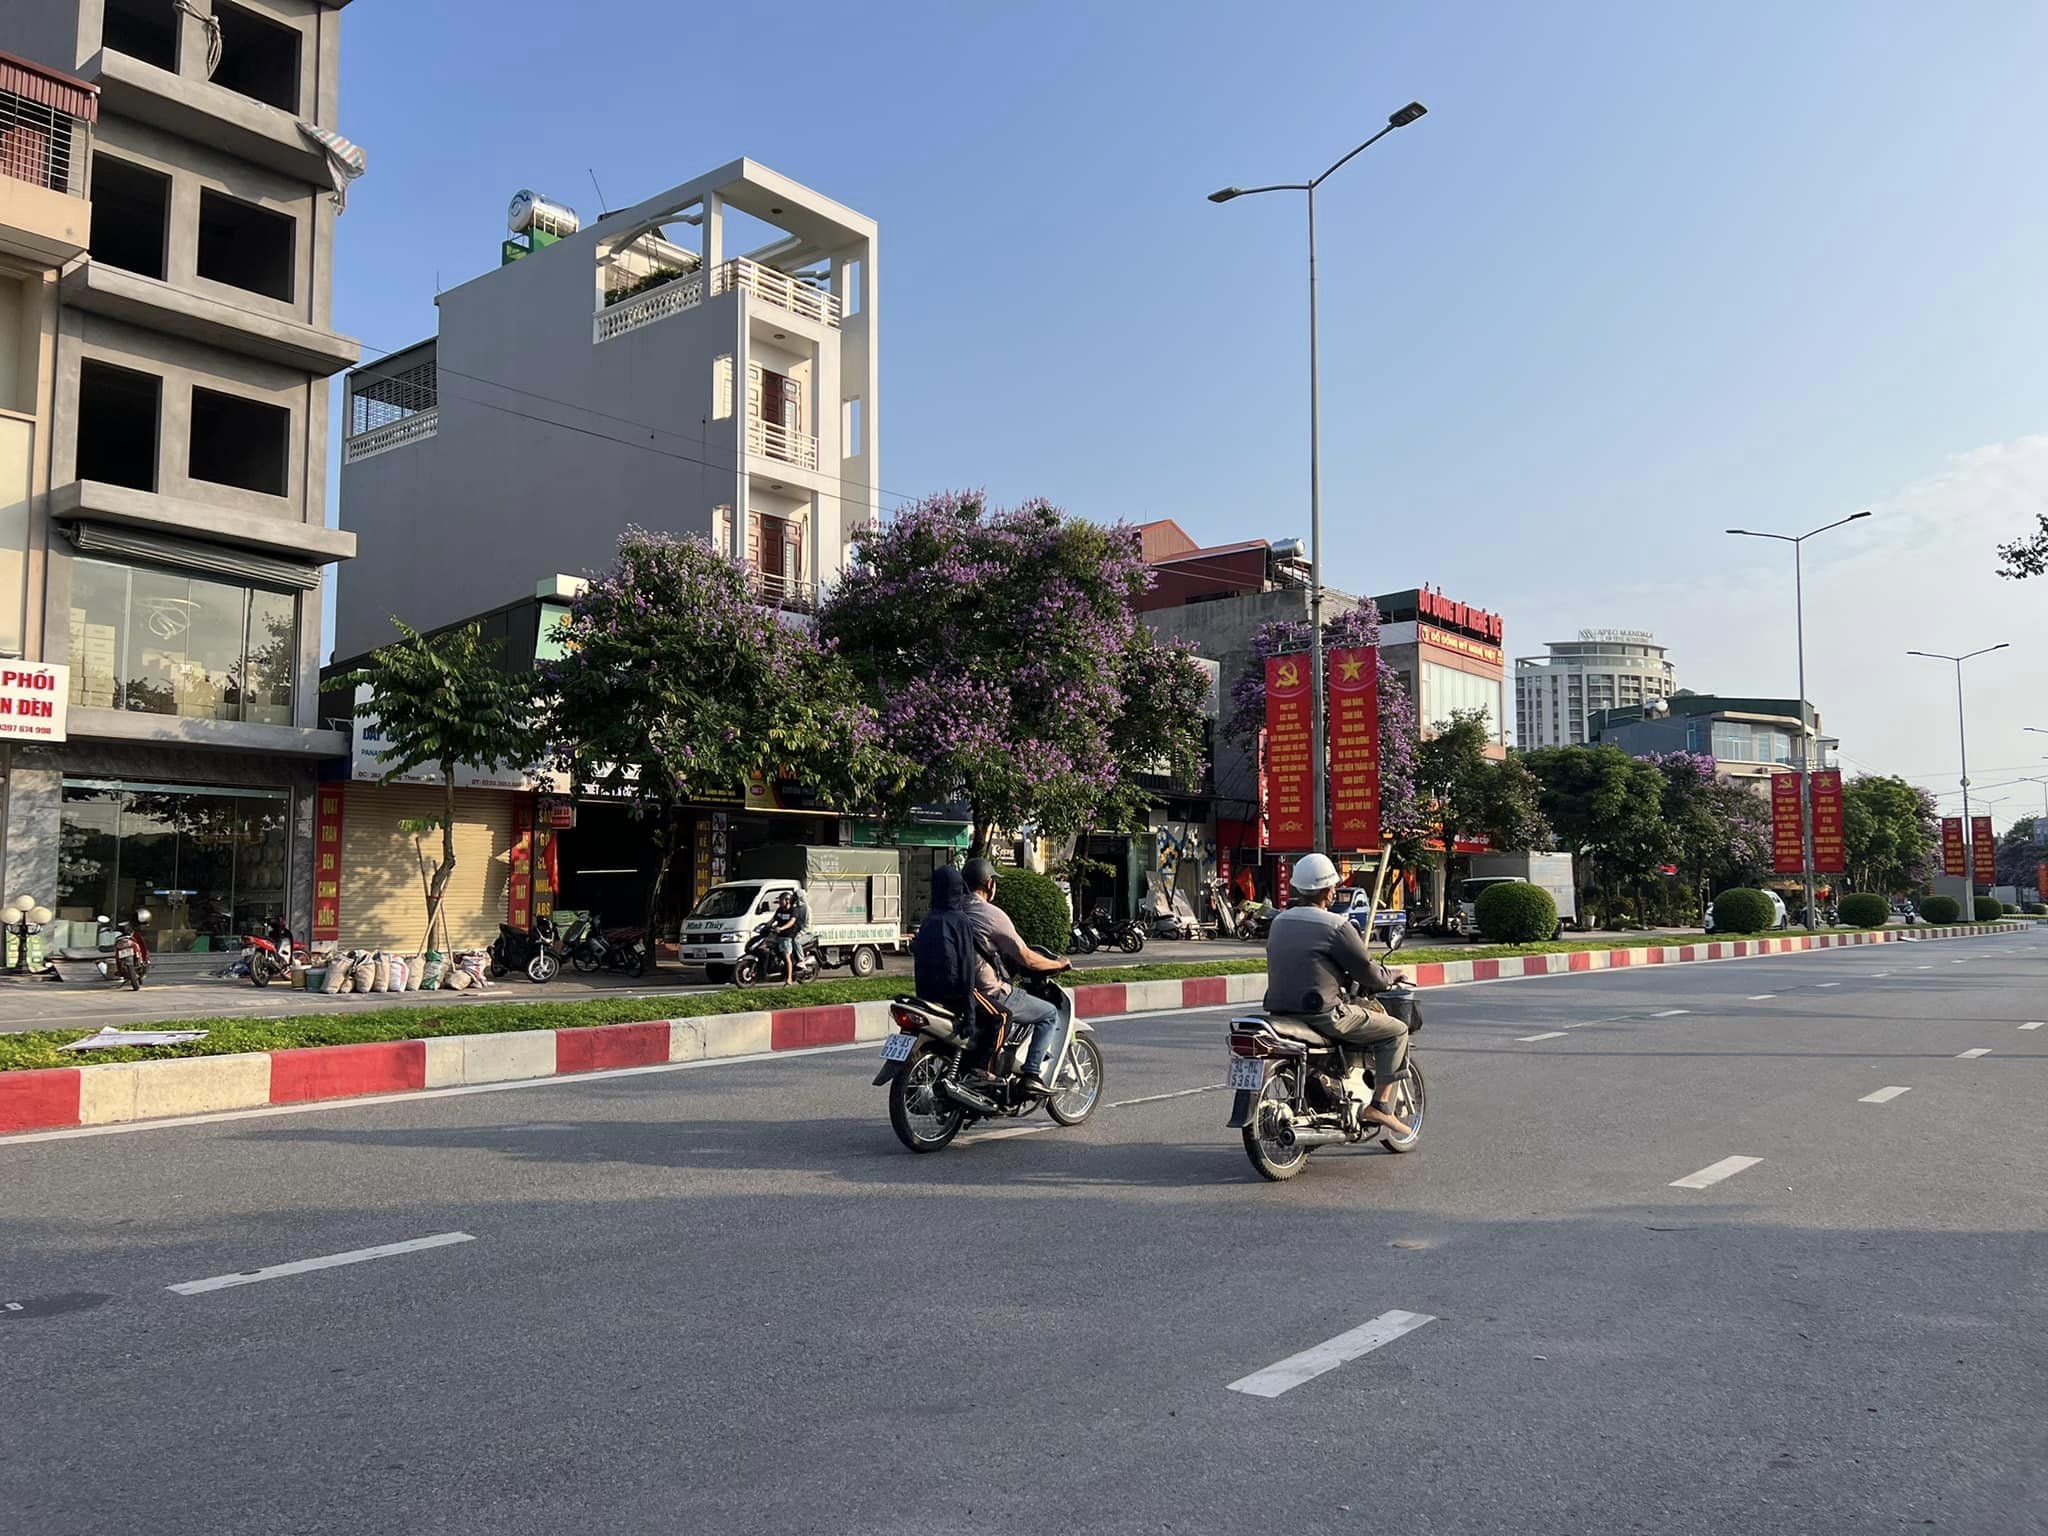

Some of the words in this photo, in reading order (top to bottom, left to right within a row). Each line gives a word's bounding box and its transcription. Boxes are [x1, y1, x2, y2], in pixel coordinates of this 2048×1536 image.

[1419, 581, 1431, 614] ĐỒ
[1432, 586, 1454, 622] ĐỒNG
[1455, 601, 1468, 628] MỸ
[1469, 608, 1488, 638] NGHỆ
[1489, 612, 1504, 642] VIỆT
[2, 668, 54, 691] PHỐI
[16, 698, 52, 718] ĐÈN
[536, 902, 550, 916] ABS
[686, 922, 702, 930] Minh
[704, 918, 724, 931] Thúy
[1232, 1074, 1256, 1088] 5364
